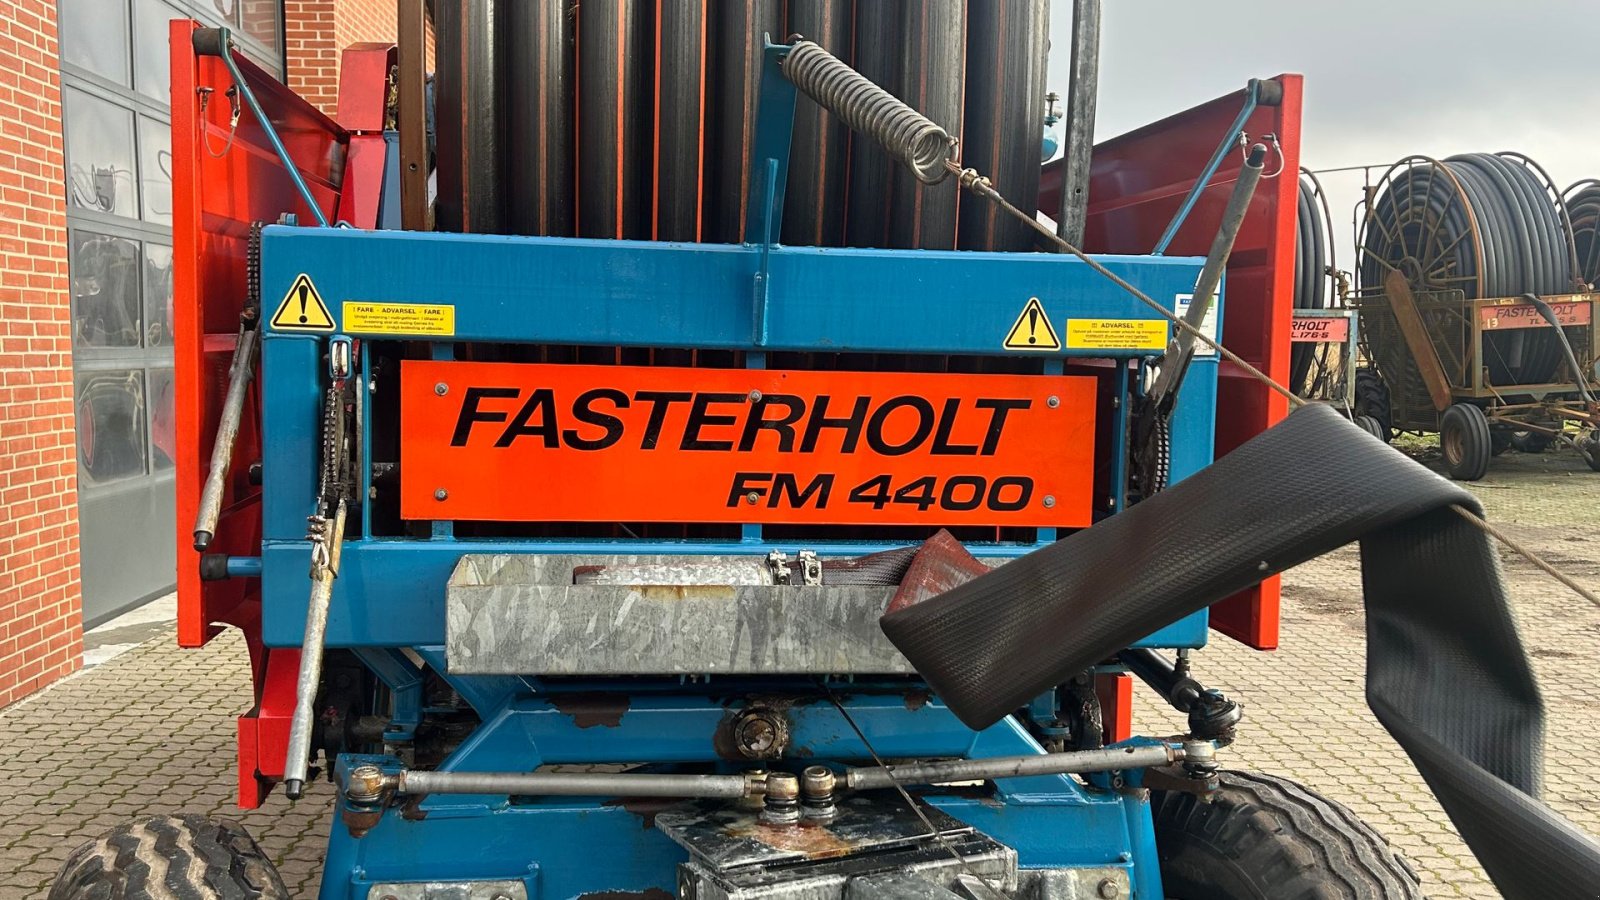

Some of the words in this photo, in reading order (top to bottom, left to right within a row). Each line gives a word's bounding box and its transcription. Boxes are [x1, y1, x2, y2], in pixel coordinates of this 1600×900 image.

[1496, 303, 1576, 318] FASTEOLT
[1291, 321, 1331, 331] RHOLT
[1487, 317, 1499, 329] 13
[451, 387, 1032, 456] FASTERHOLT
[726, 472, 835, 509] FM
[848, 474, 1034, 512] 4400
